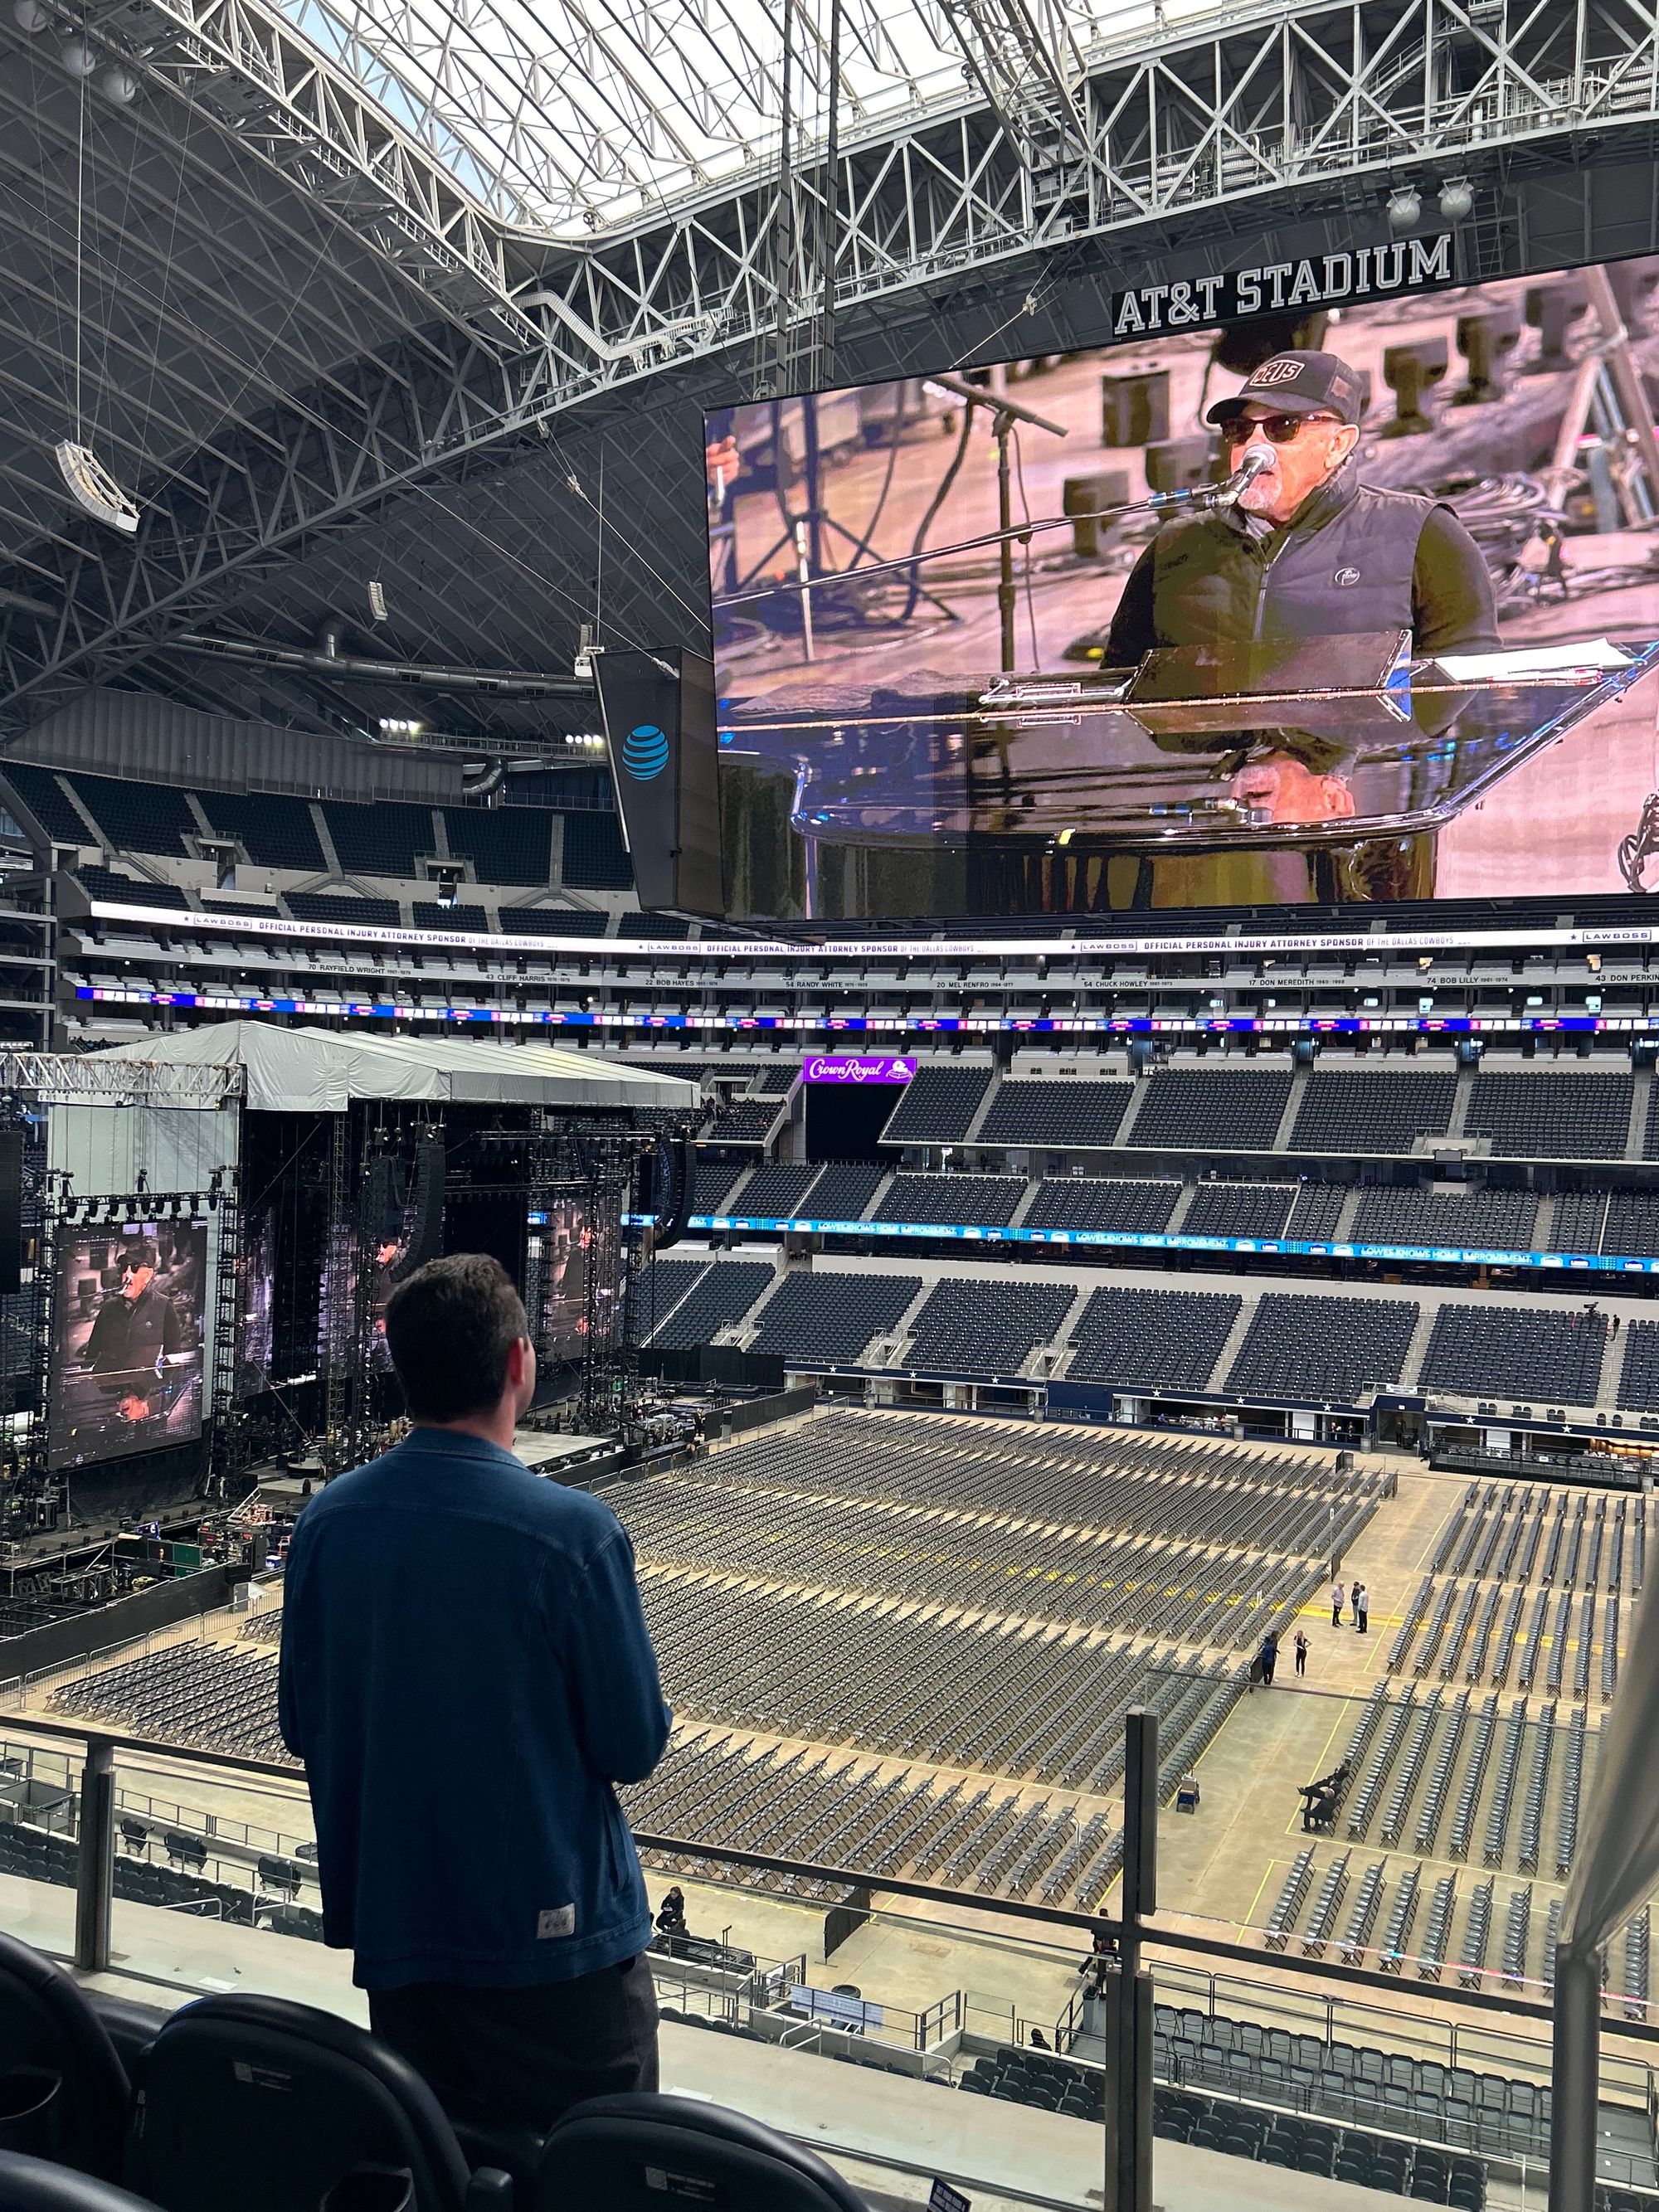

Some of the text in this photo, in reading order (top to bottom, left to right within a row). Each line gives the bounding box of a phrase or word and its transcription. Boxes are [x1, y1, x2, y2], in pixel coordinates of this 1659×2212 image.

[1114, 234, 1451, 335] AT&T STADIUM
[1253, 362, 1298, 383] DEUS
[197, 917, 250, 927] LAWBOSS
[259, 921, 297, 932] OFFICIAL
[299, 926, 344, 936] PERSONAL
[347, 929, 377, 938] INJURY
[381, 931, 424, 941] ATTORNEY
[427, 934, 466, 943] SPONSOR
[1270, 939, 1316, 947] ATTORNEY
[1321, 938, 1363, 946] SPONSOR
[1392, 936, 1418, 946] DALLAS
[1419, 936, 1453, 945] COWBOYS
[319, 964, 354, 973] RAYFIELD
[809, 1058, 885, 1082] Crown Royal
